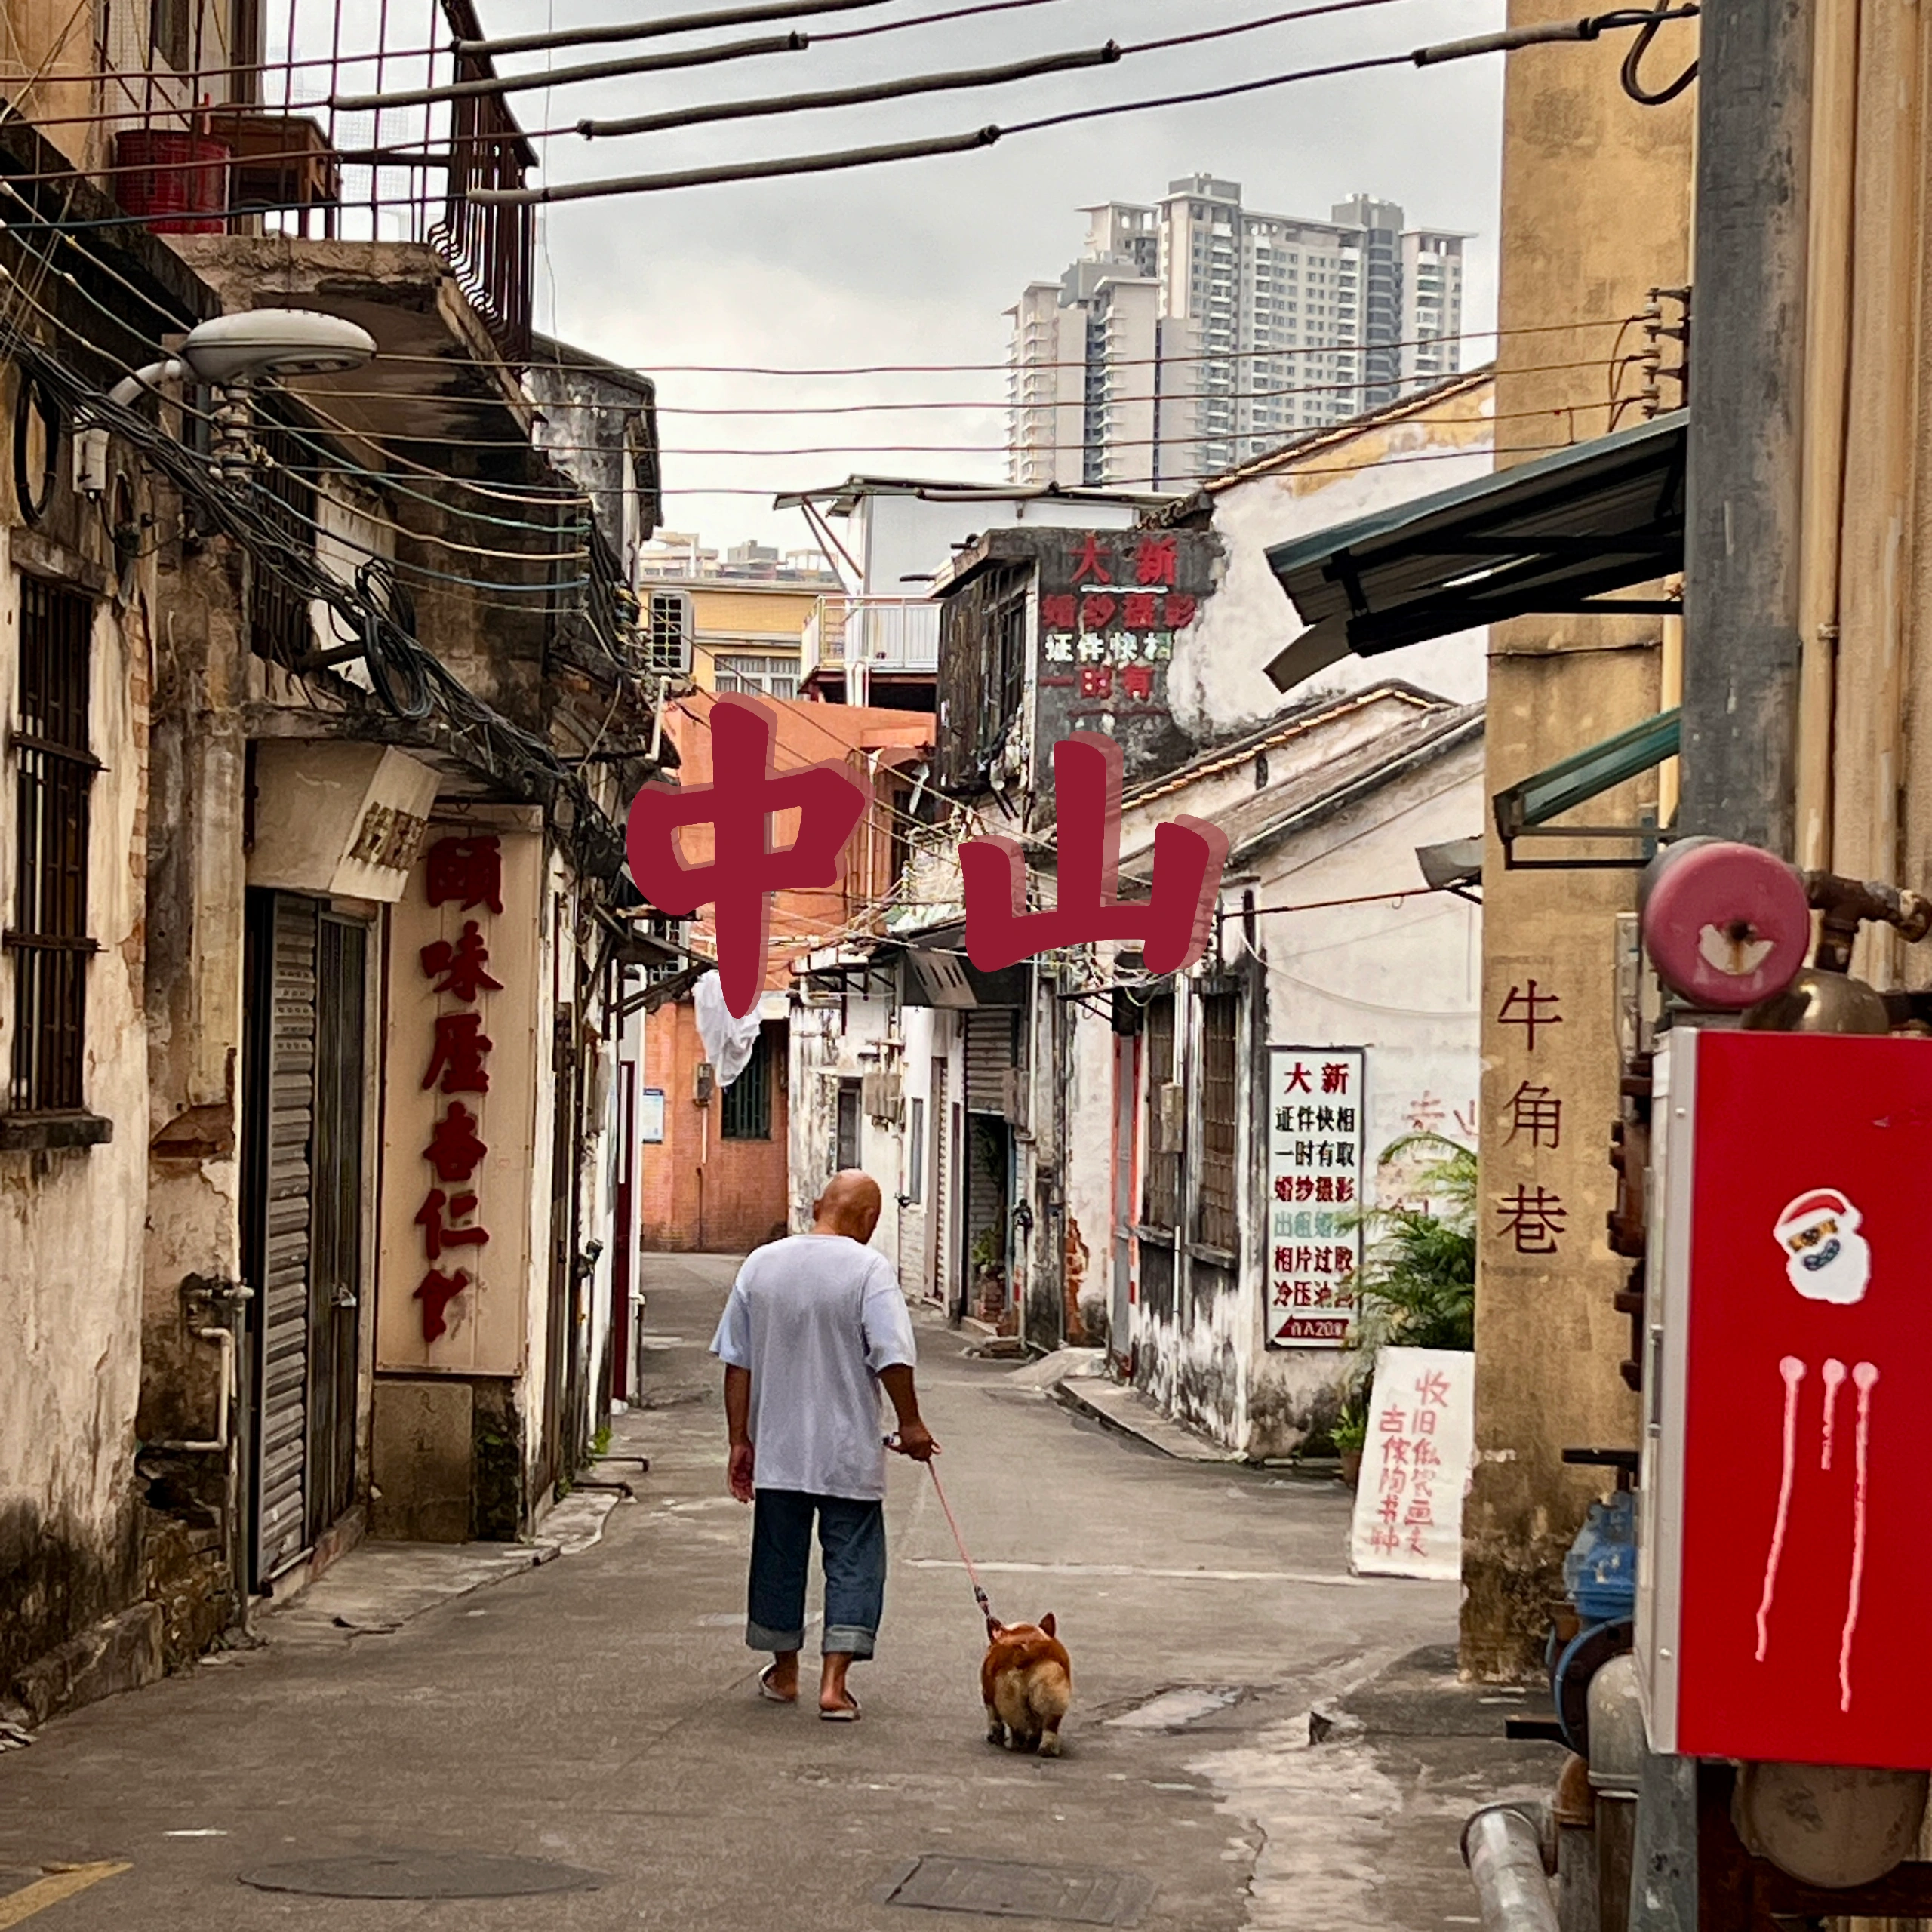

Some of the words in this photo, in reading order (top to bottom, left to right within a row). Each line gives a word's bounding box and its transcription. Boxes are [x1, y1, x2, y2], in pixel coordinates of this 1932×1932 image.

[1068, 531, 1177, 586] 大新
[1284, 1062, 1350, 1094] 大新
[1275, 1106, 1356, 1133] 证件快相
[1497, 979, 1568, 1254] 牛角巷
[1274, 1140, 1355, 1168] 一时有取
[1273, 1175, 1355, 1203] 婚纱摄影
[1274, 1245, 1354, 1274] 相片过胶
